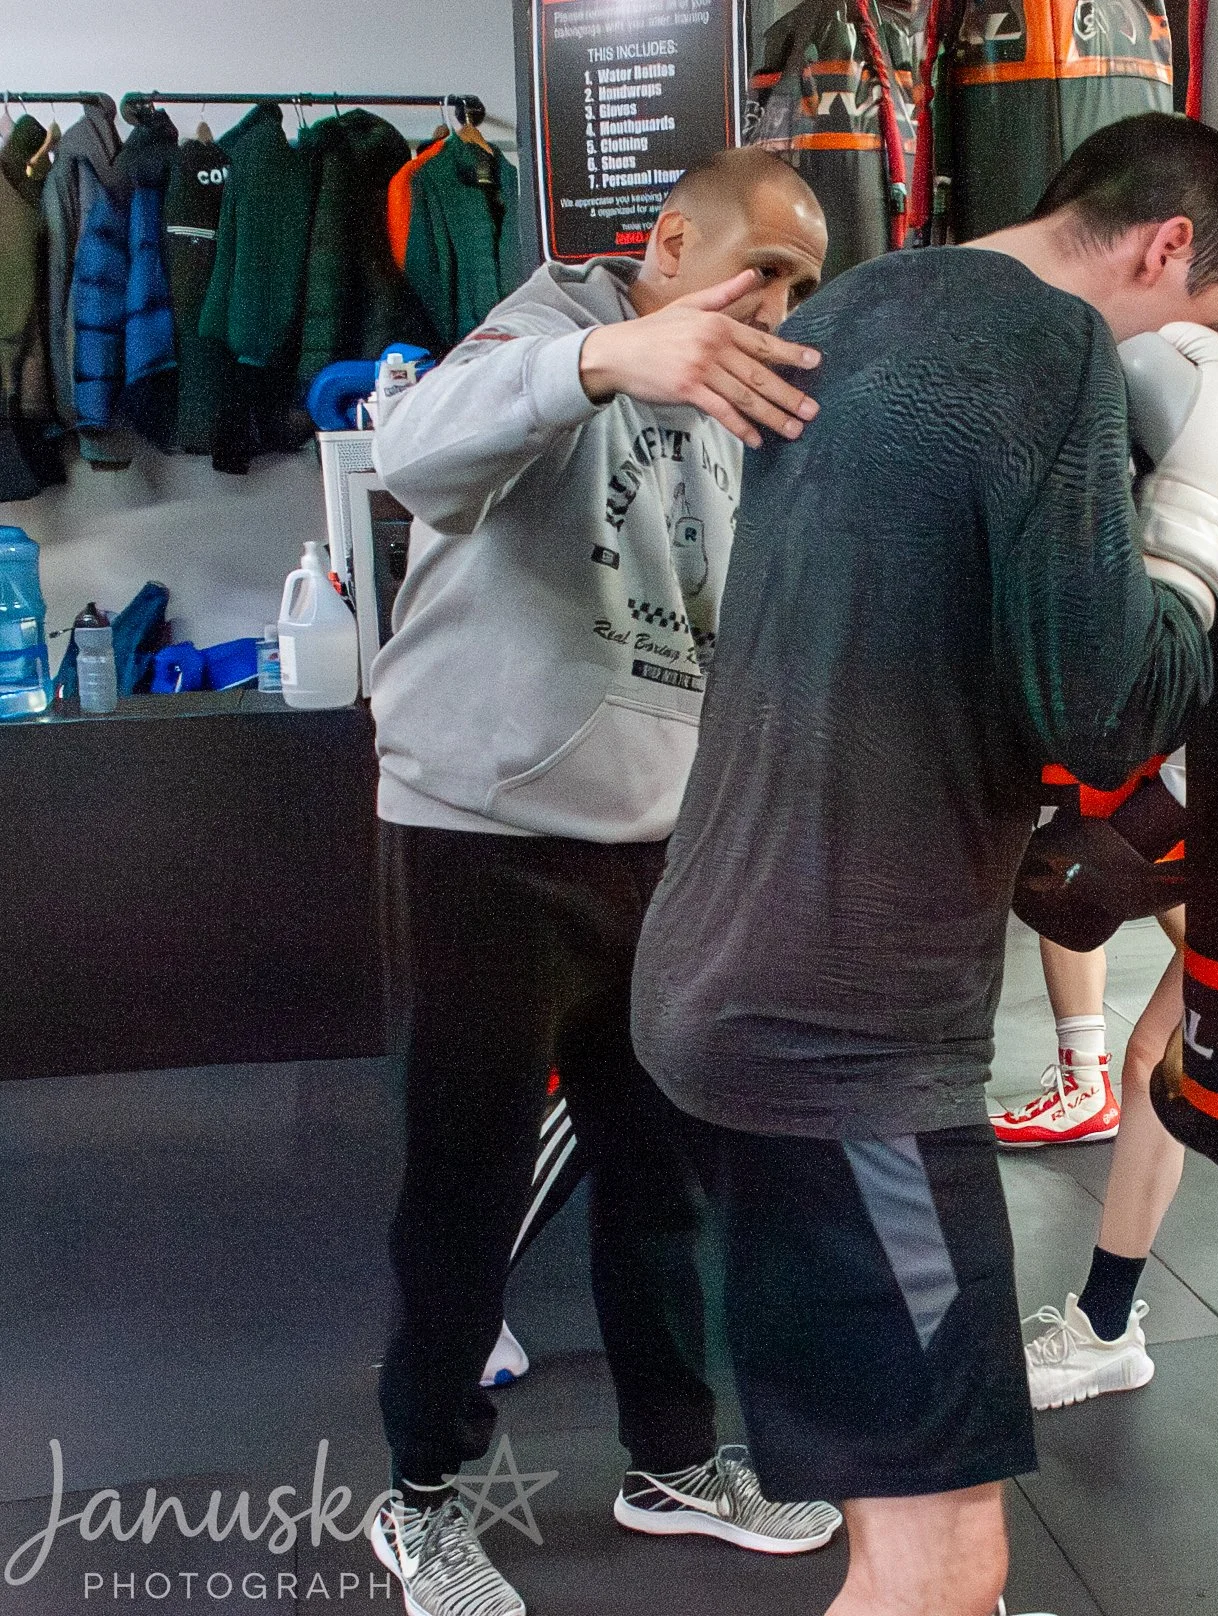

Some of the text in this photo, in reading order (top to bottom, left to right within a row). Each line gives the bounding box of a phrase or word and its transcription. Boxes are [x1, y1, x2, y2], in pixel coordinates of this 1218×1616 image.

[588, 47, 614, 62] THIS
[584, 63, 675, 86] 1. Water Bottles
[584, 83, 662, 103] 2. Handwraps
[599, 103, 637, 119] Gloves
[600, 114, 676, 137] Mouthguards
[600, 136, 648, 153] Clothing
[601, 155, 636, 171] Shoes
[602, 169, 652, 188] Personal
[593, 620, 632, 645] Real
[634, 632, 681, 664] Boxing
[1051, 1085, 1100, 1122] RVAL
